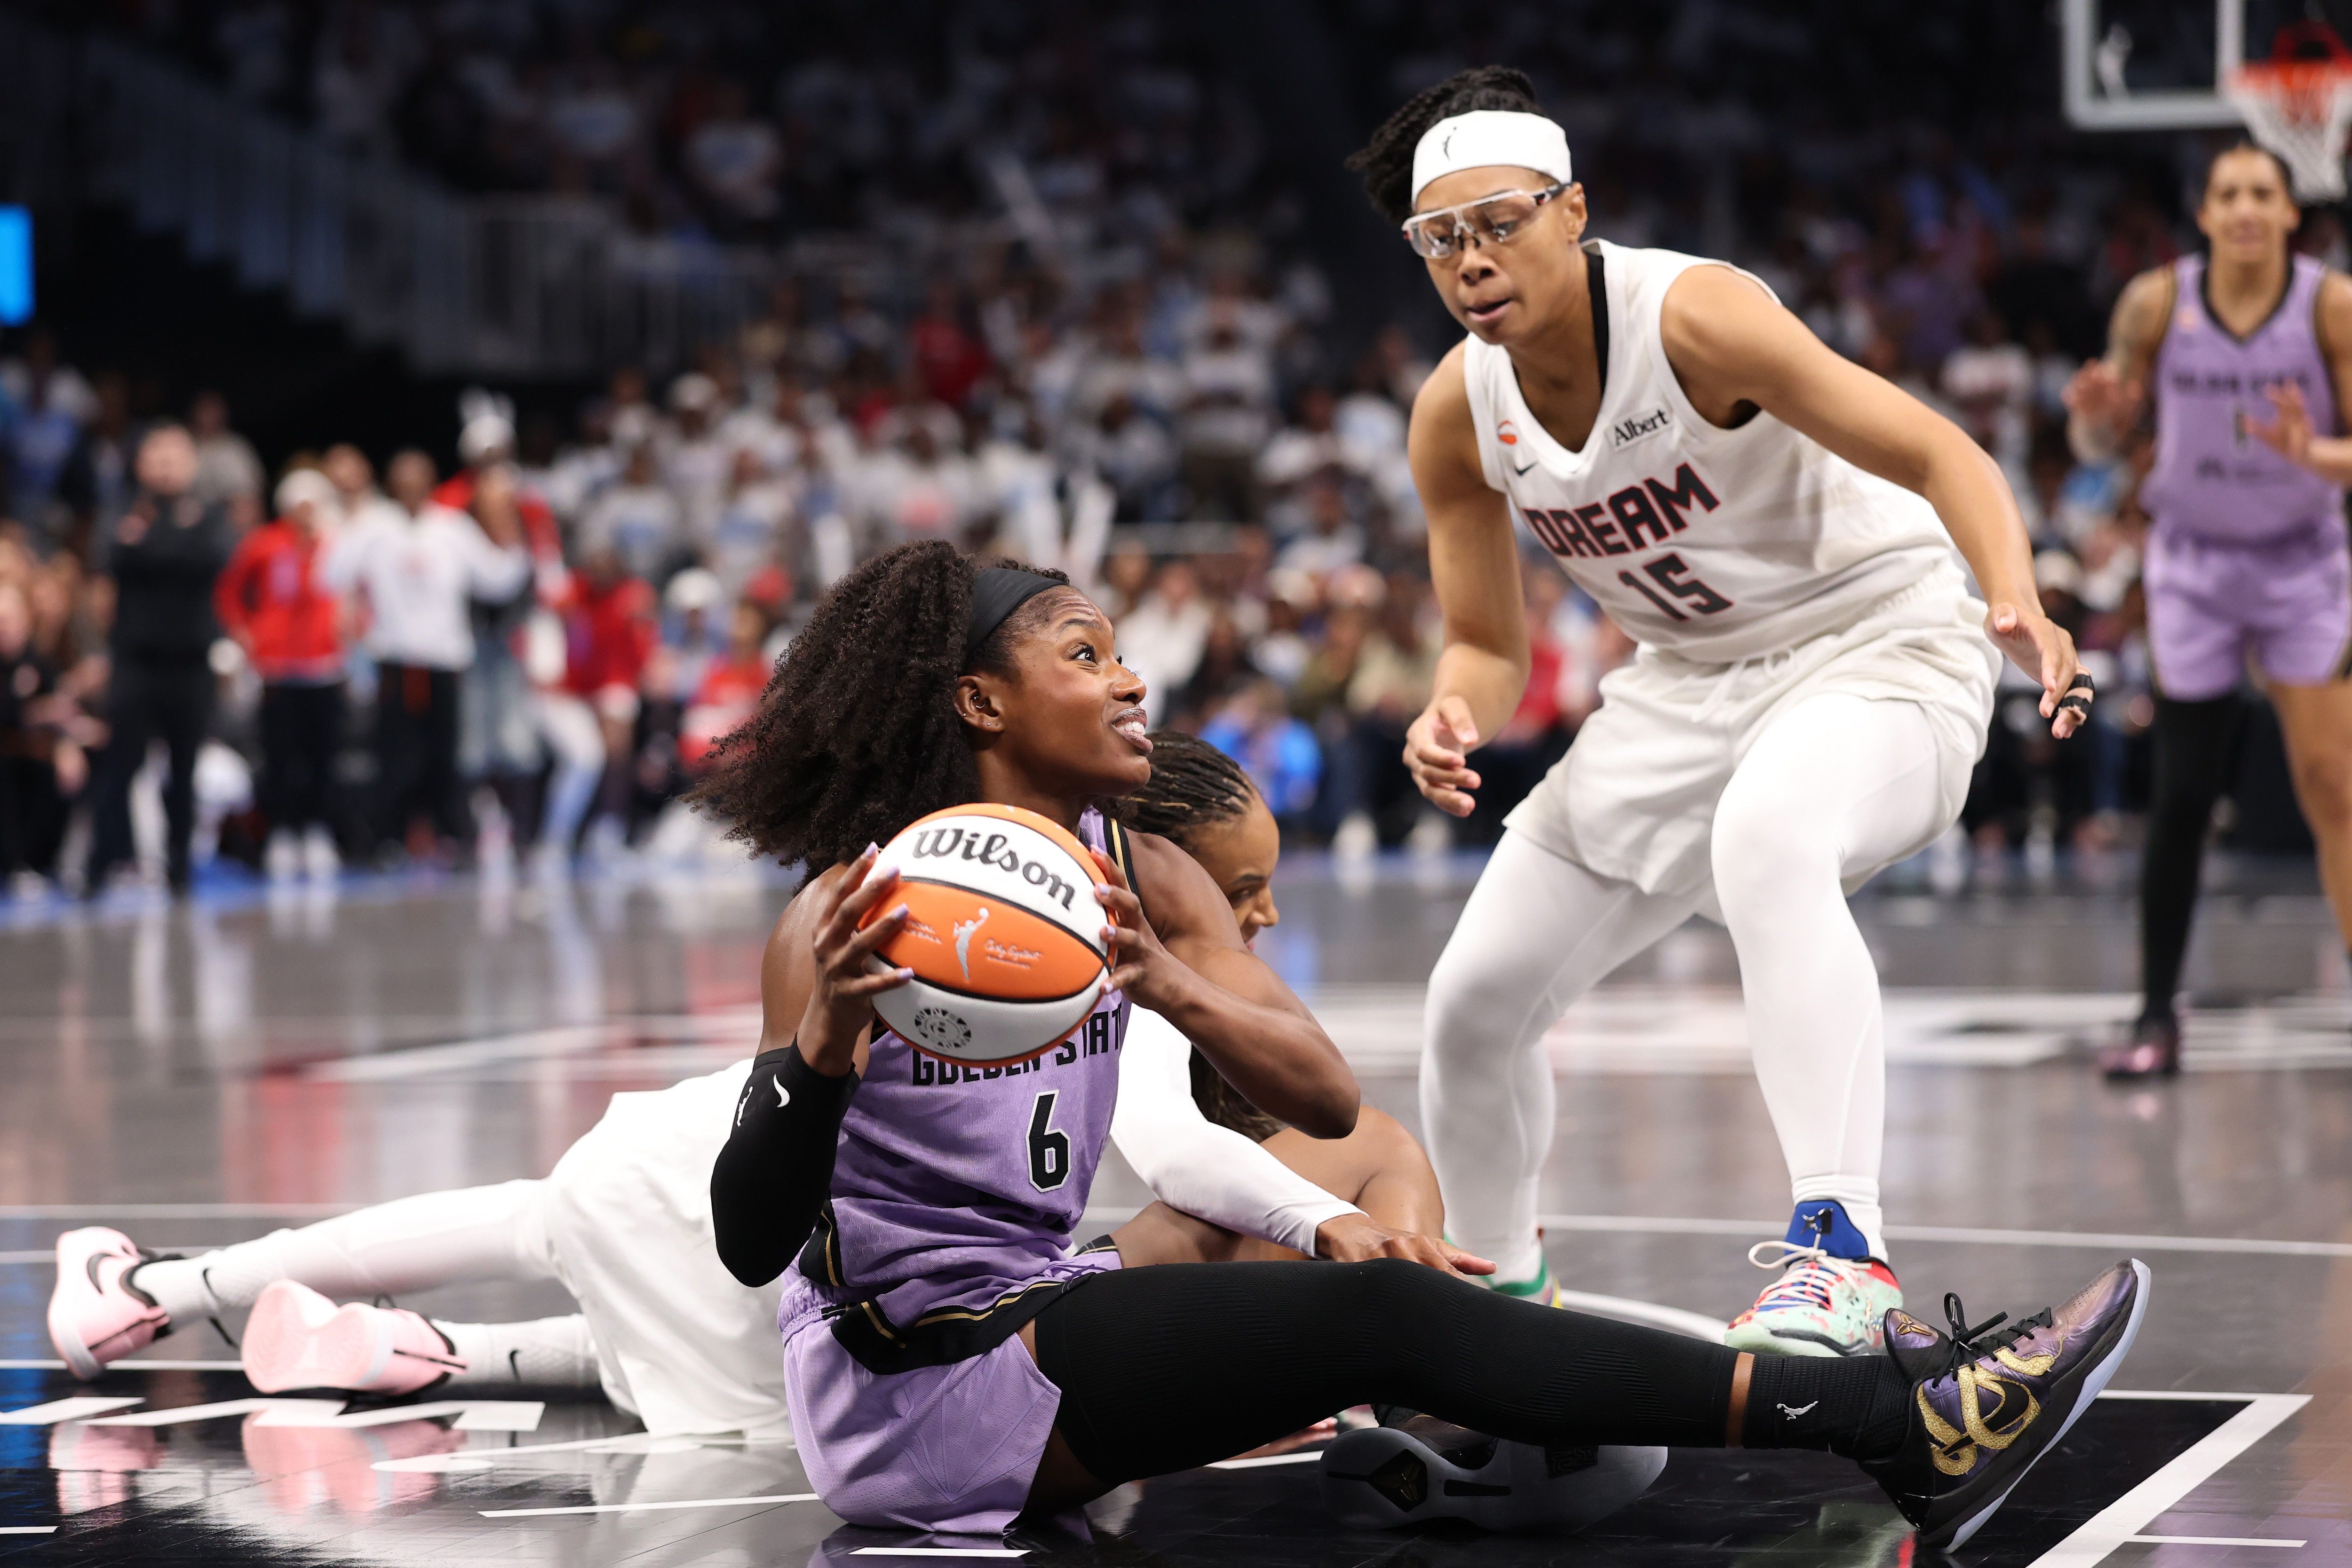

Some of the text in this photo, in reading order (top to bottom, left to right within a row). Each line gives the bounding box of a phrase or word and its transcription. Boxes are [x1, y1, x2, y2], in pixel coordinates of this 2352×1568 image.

[1613, 408, 1669, 447] Albert
[1523, 462, 1721, 558] DREAM
[1617, 552, 1734, 622] 15
[913, 828, 1075, 911] Wilson
[1025, 1090, 1071, 1192] 6
